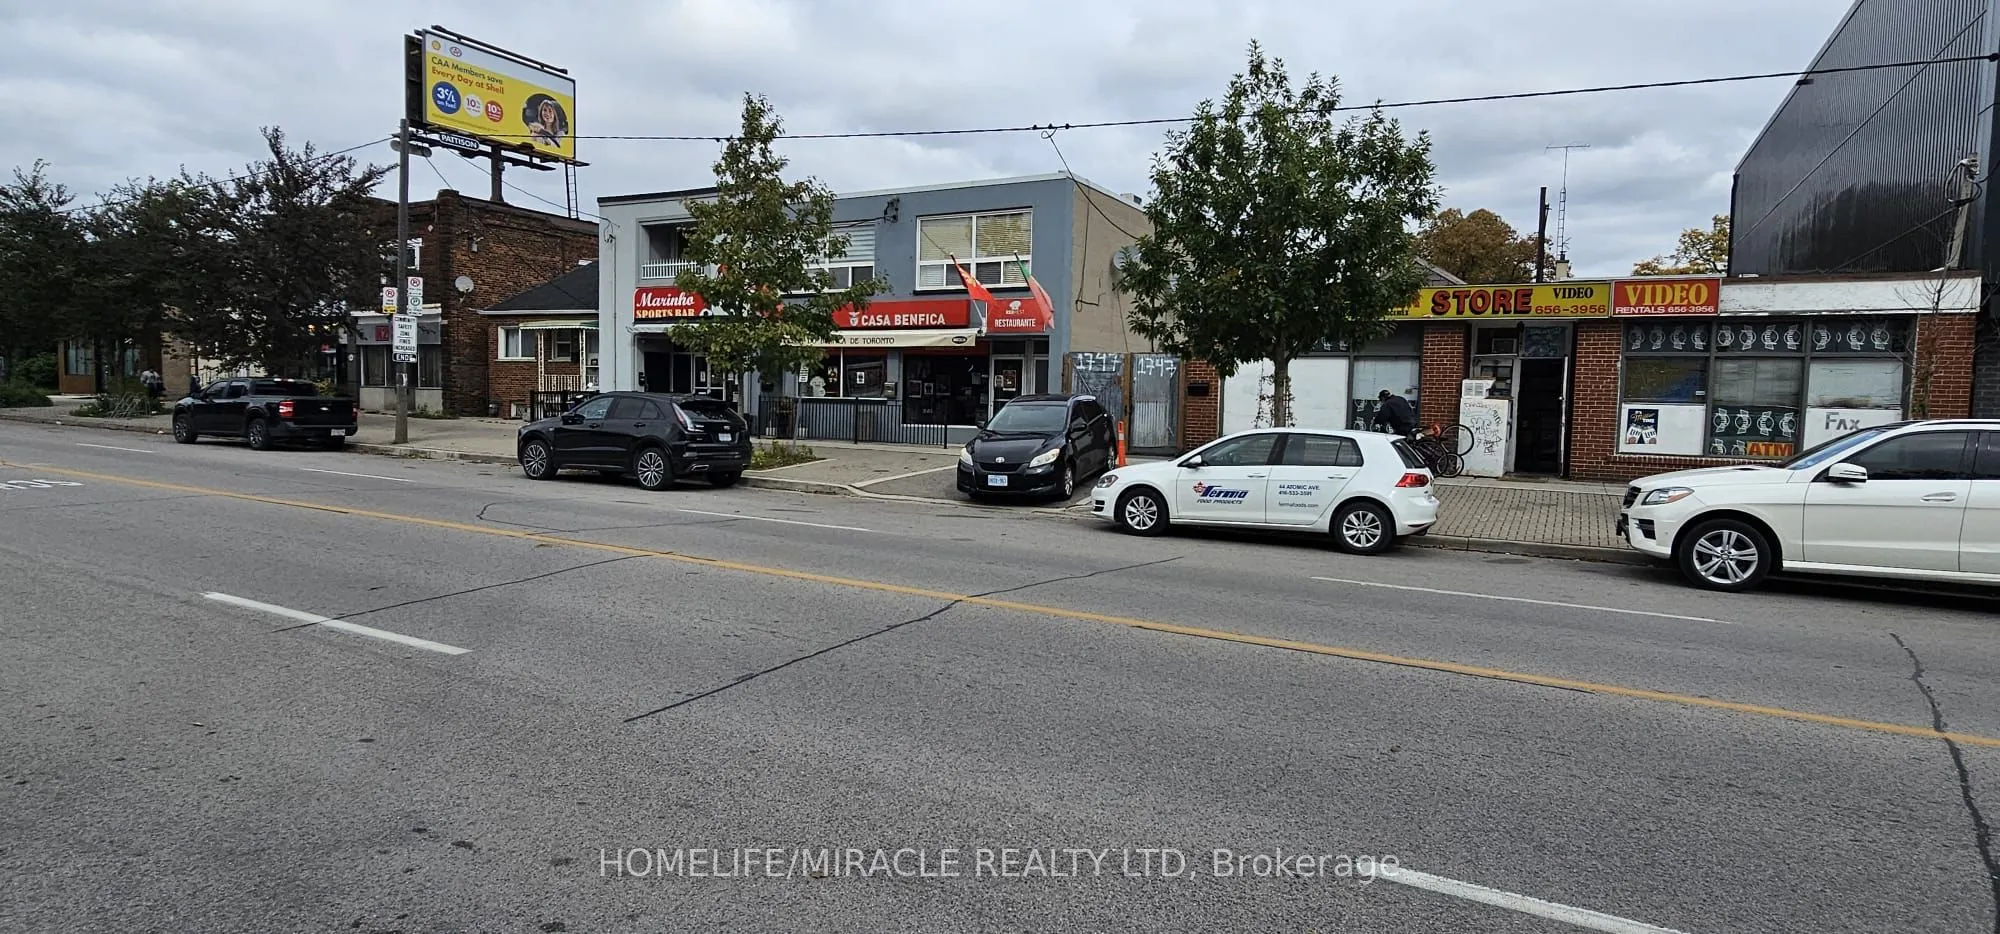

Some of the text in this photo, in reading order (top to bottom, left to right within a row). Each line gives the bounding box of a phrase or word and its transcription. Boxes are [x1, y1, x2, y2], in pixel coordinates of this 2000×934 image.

[431, 56, 504, 85] CAA Members save
[431, 66, 505, 94] Every Day at Shell
[441, 134, 477, 149] PATTISON
[636, 291, 695, 307] Marinho
[1553, 287, 1594, 299] VIDEO
[1624, 283, 1709, 306] VIDEO
[1430, 288, 1533, 316] STORE
[636, 308, 695, 318] SPORTS BAR
[1535, 304, 1607, 315] 656-3956
[1615, 306, 1665, 314] RENTALS
[861, 313, 946, 327] CASA BENFICA
[994, 318, 1036, 328] RESTAURANTE
[850, 337, 859, 345] DE
[862, 336, 895, 345] TORONTO
[1076, 352, 1121, 372] 1747
[1137, 357, 1177, 377] 1747
[1749, 443, 1793, 457] ATM
